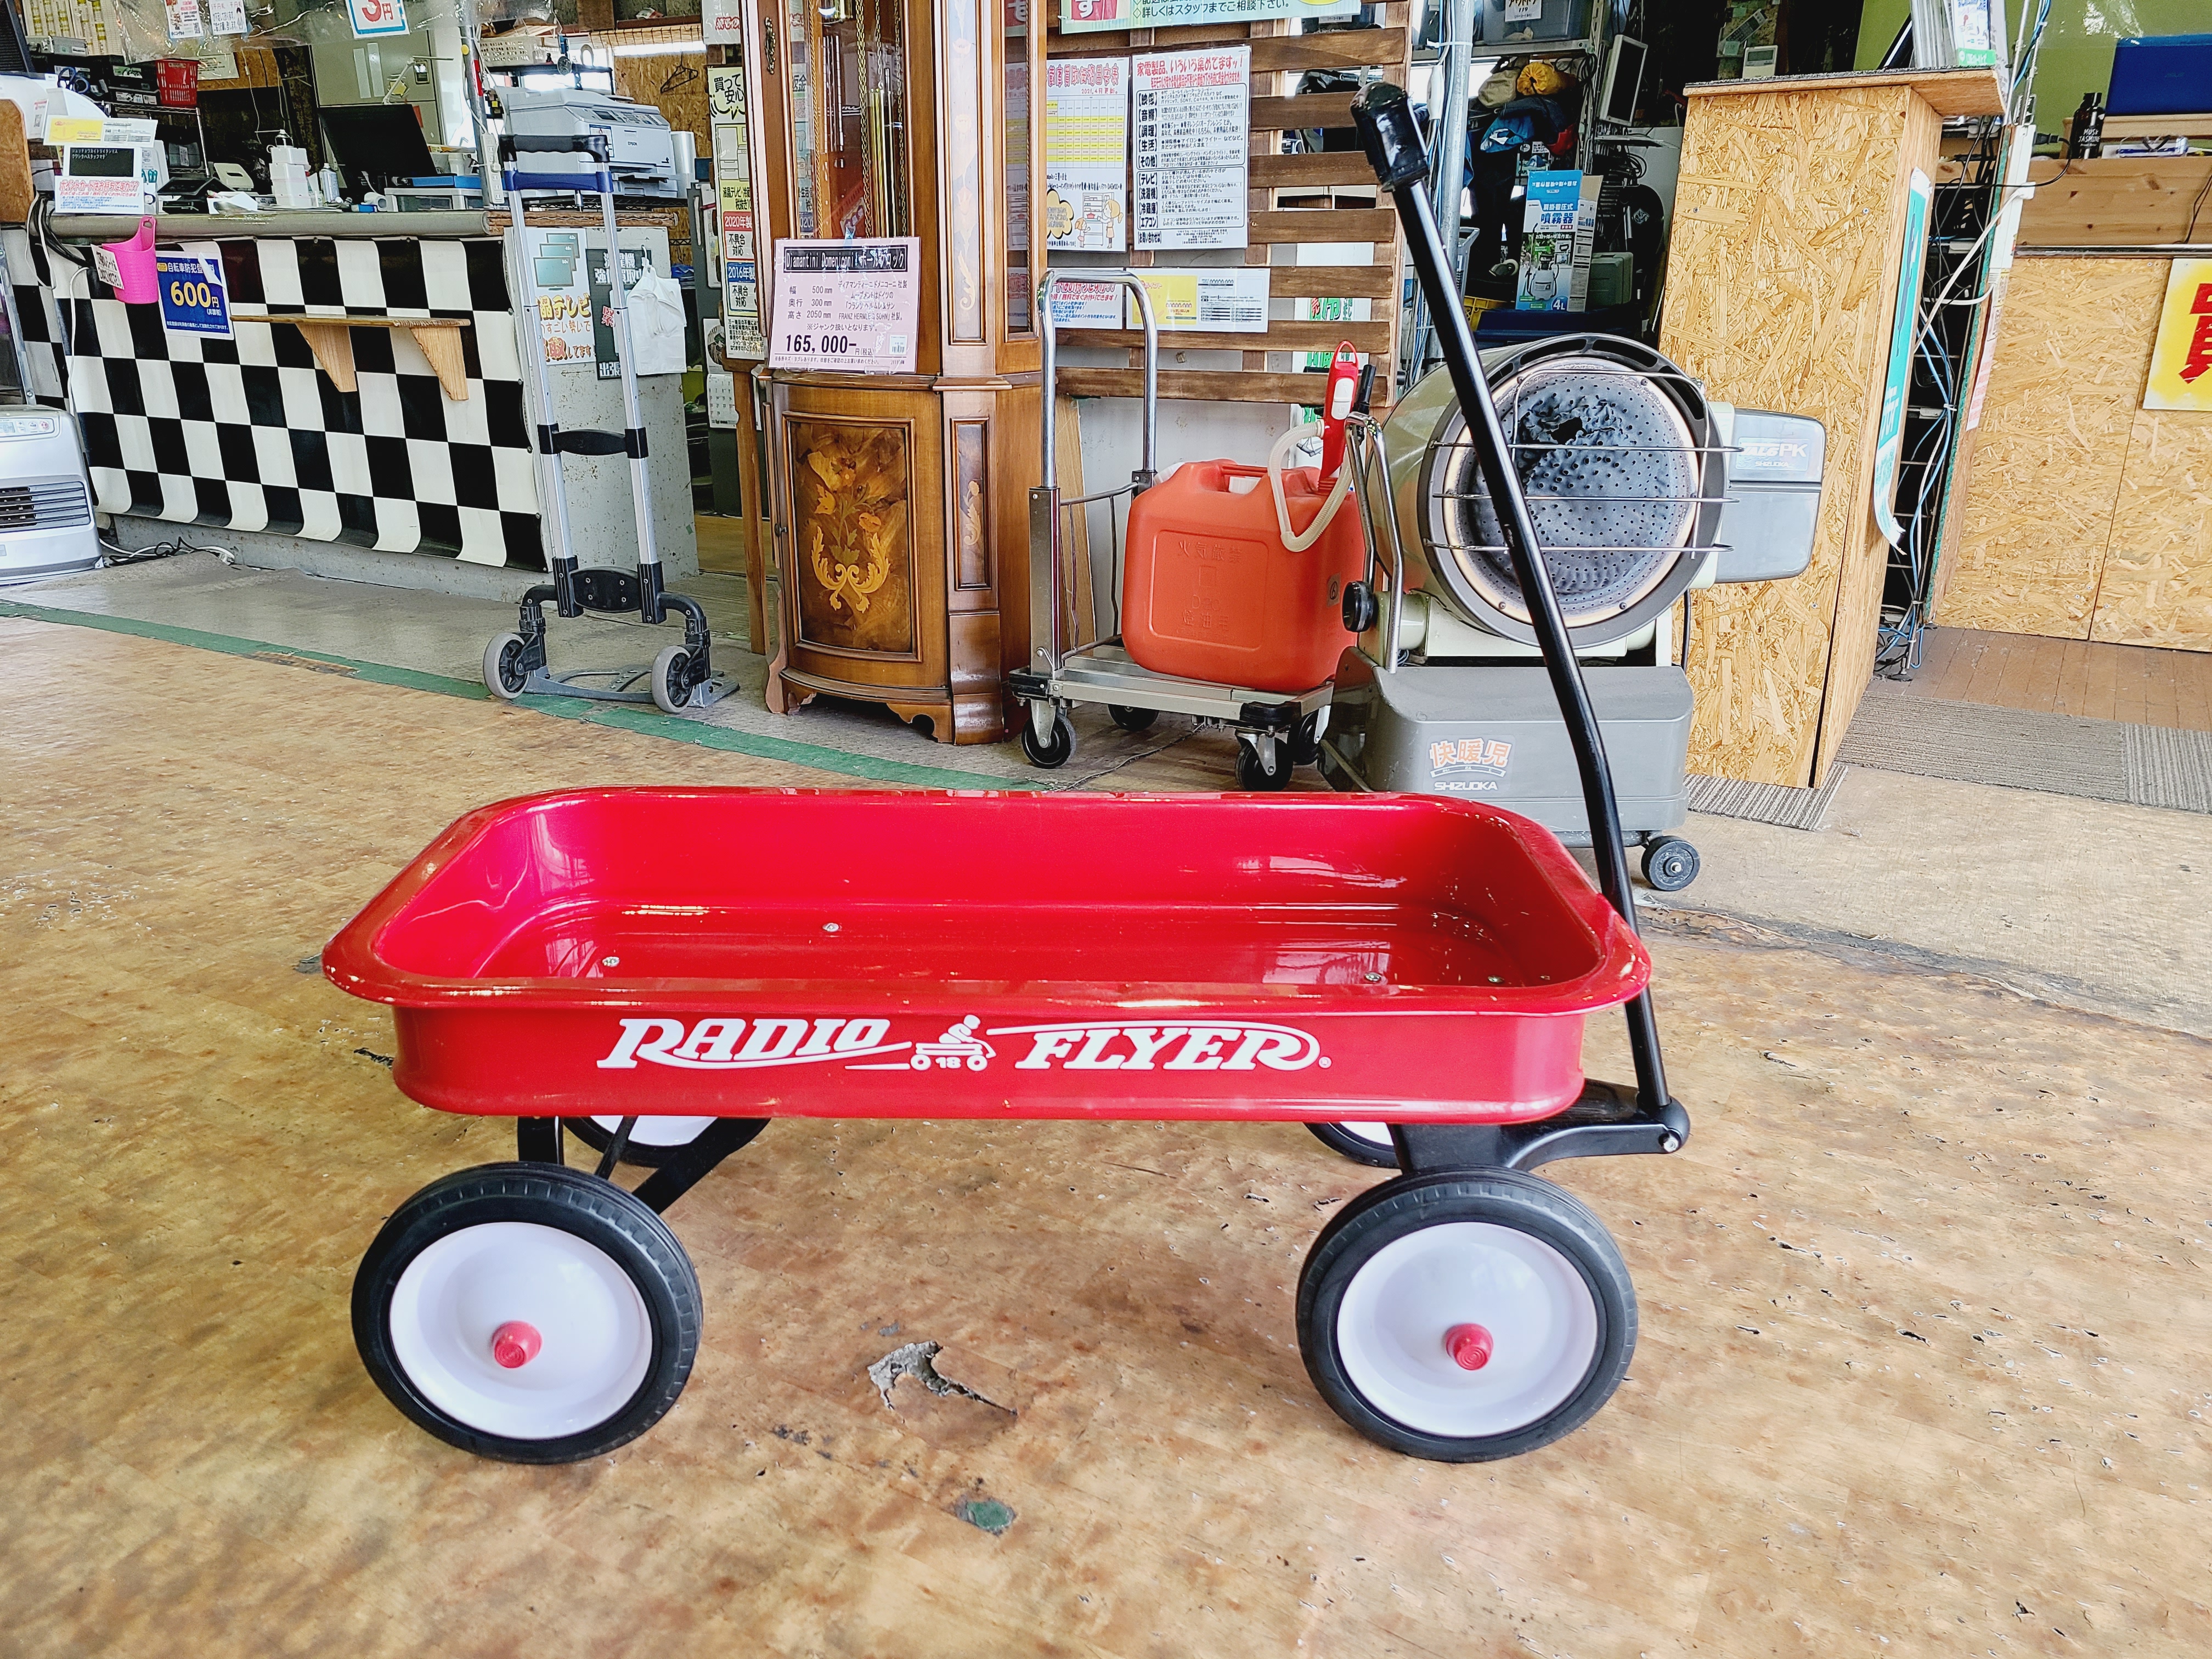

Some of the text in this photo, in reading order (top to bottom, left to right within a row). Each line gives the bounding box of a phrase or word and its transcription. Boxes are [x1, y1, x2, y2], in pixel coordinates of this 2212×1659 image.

[714, 73, 741, 93] 買って
[1541, 212, 1573, 224] 噴霧器
[729, 234, 746, 245] 不具合
[732, 246, 744, 256] 対応
[786, 251, 819, 268] Diamantini
[168, 262, 215, 275] 自転車防犯登
[732, 285, 748, 296] 不具合
[789, 286, 797, 295] 幅
[535, 292, 591, 320] 晶テレビ
[735, 298, 747, 307] 対応
[1553, 299, 1566, 310] 4L
[1429, 738, 1513, 769] 快暖児
[1434, 781, 1498, 791] SHIZUOKA
[596, 1018, 1321, 1071] RADIO FLYER
[935, 1057, 962, 1069] 18
